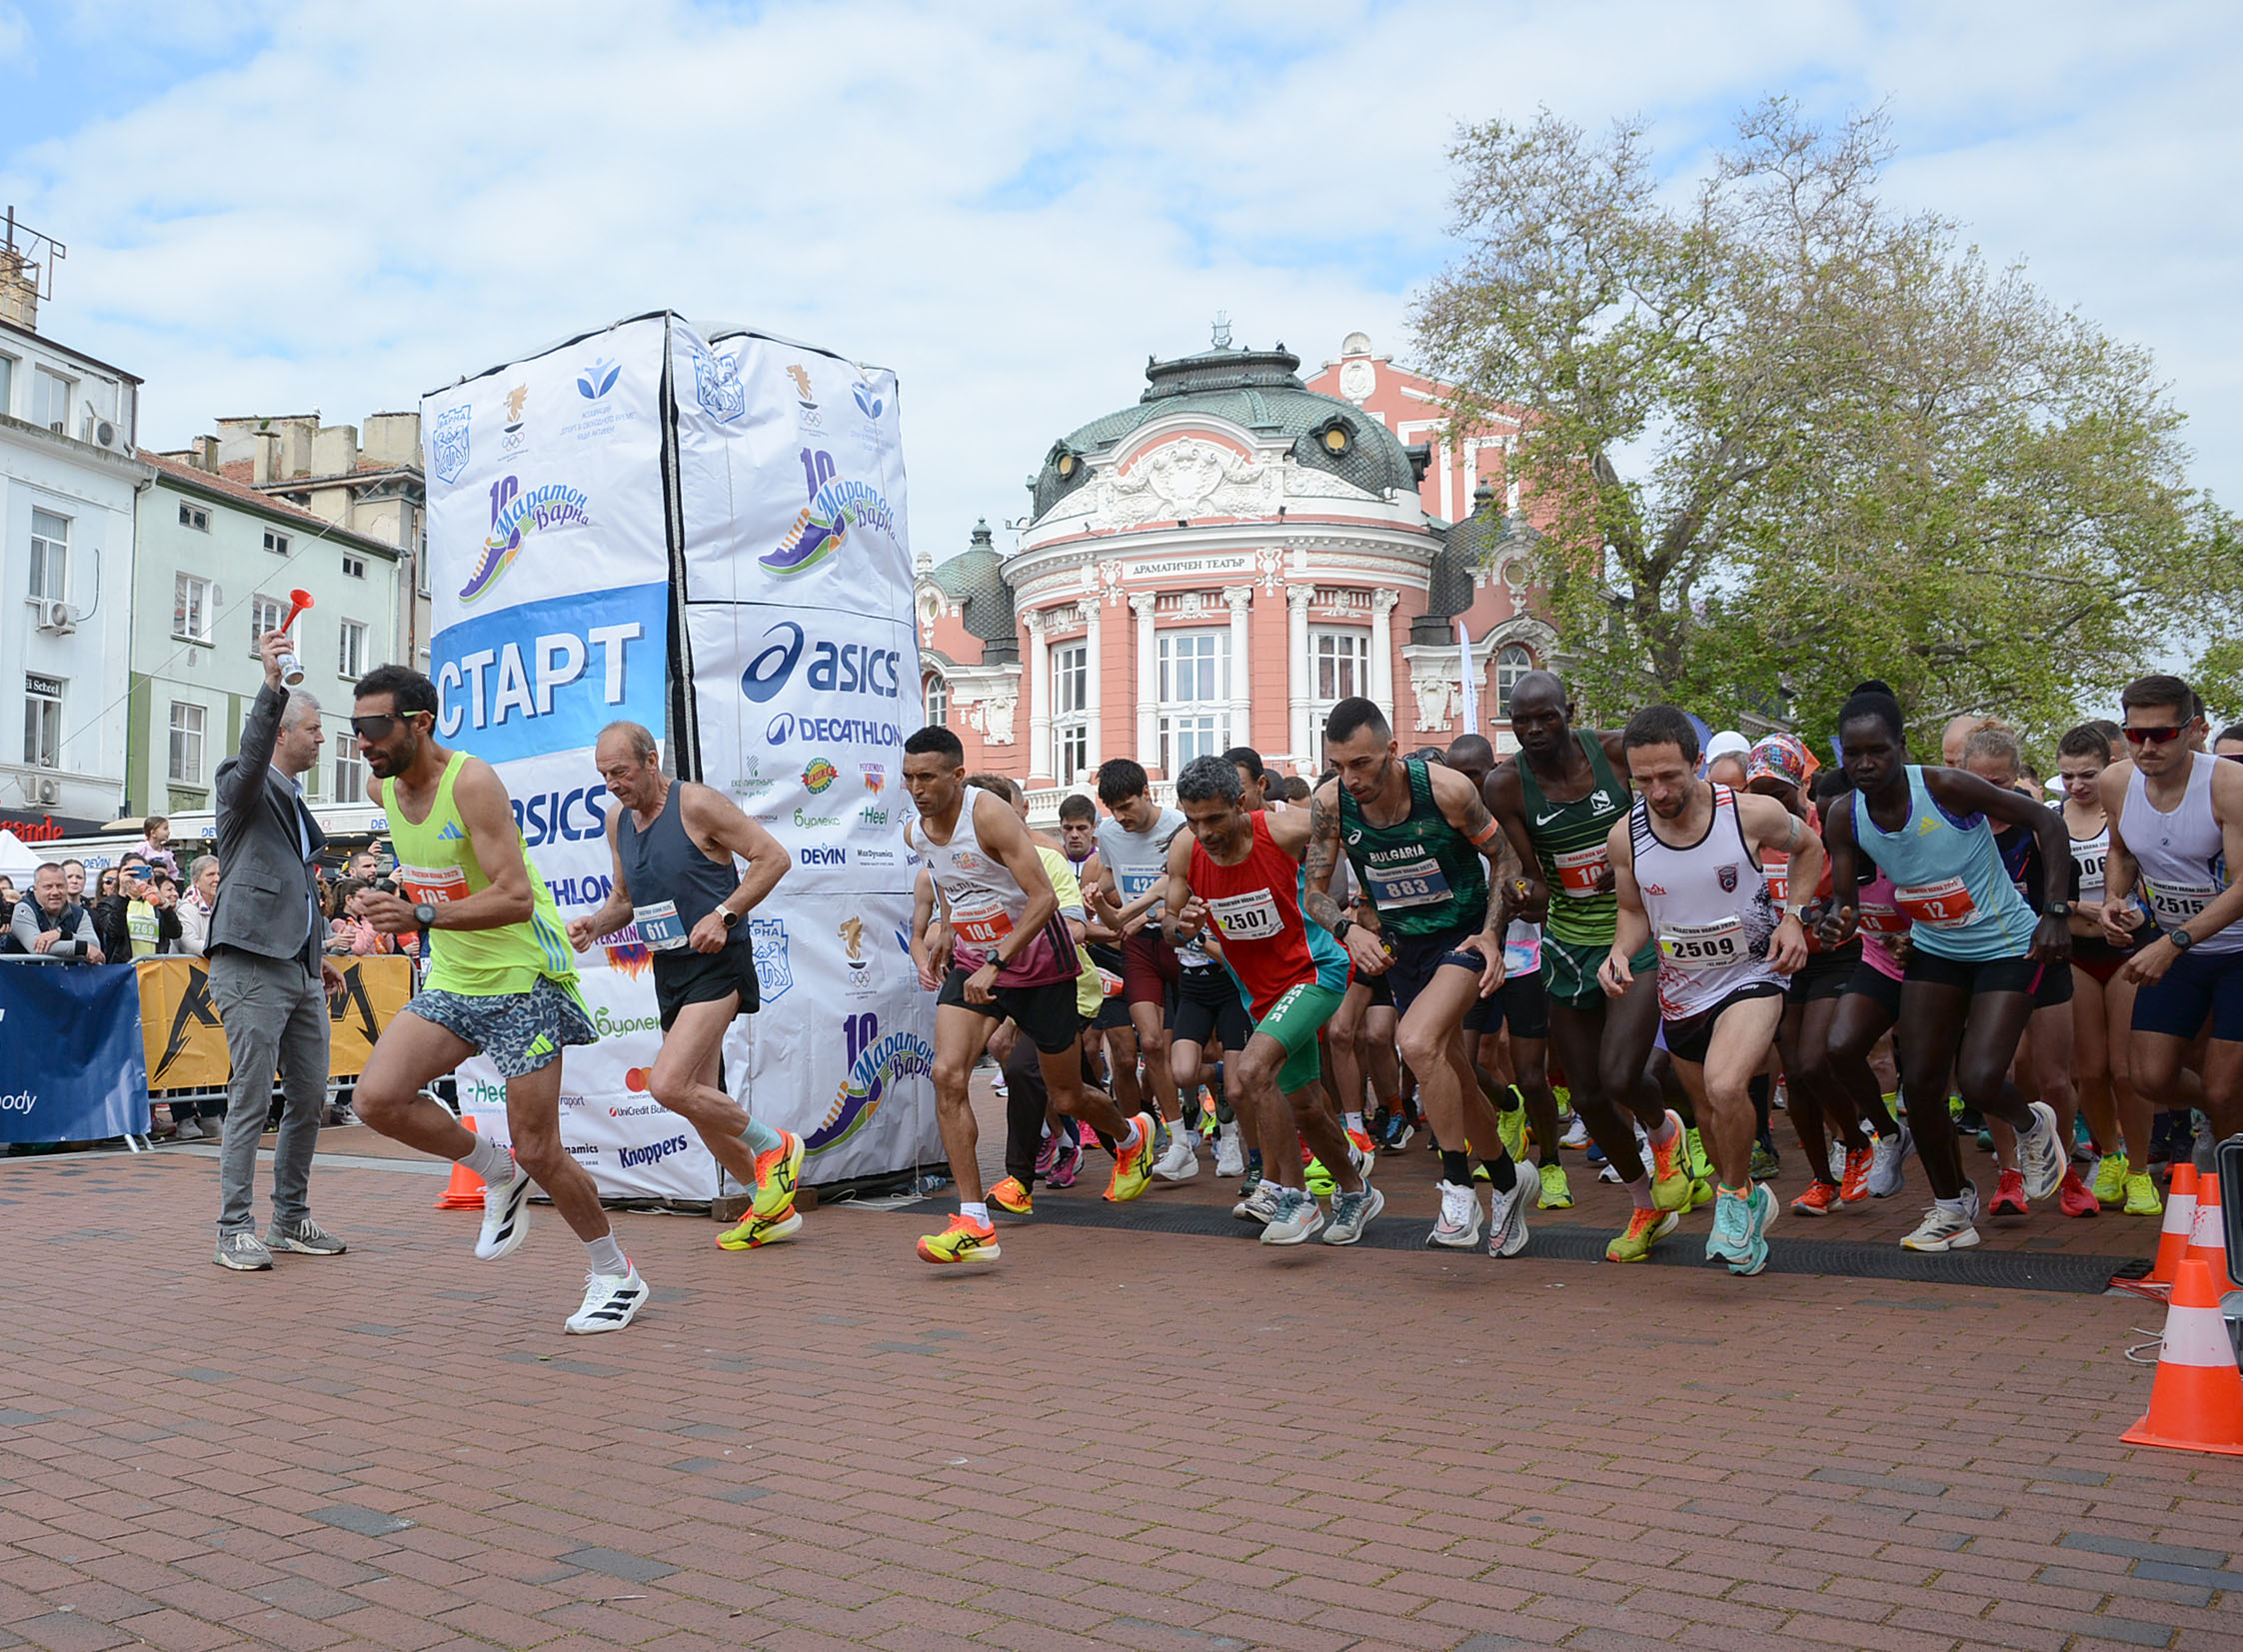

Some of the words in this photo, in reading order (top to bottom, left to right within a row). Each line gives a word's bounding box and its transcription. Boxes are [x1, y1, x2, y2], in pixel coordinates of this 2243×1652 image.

[800, 447, 837, 505] 10
[490, 475, 519, 532] 10
[496, 484, 588, 543] Маратон
[532, 503, 590, 531] Варна
[1132, 561, 1202, 575] ДРАМАТИЧЕН
[1206, 559, 1245, 570] ТЕАТЪР
[807, 641, 901, 698] asics
[437, 622, 645, 739] СТАРТ
[799, 718, 904, 747] DECATHLON
[83, 855, 111, 868] DEVIN
[801, 847, 847, 866] DEVIN
[1369, 843, 1426, 862] BULGARIA
[417, 888, 451, 904] 105
[1385, 878, 1429, 897] 883
[1923, 901, 1949, 918] 12
[2155, 895, 2204, 914] 2515
[1223, 908, 1267, 929] 2507
[646, 920, 669, 940] 611
[966, 922, 997, 940] 104
[1671, 937, 1734, 958] 2509
[844, 1011, 878, 1076] 10
[855, 1031, 936, 1090] Маратон
[0, 1089, 37, 1115] ody
[618, 1104, 650, 1117] UniCredit
[618, 1134, 688, 1169] Knoppers
